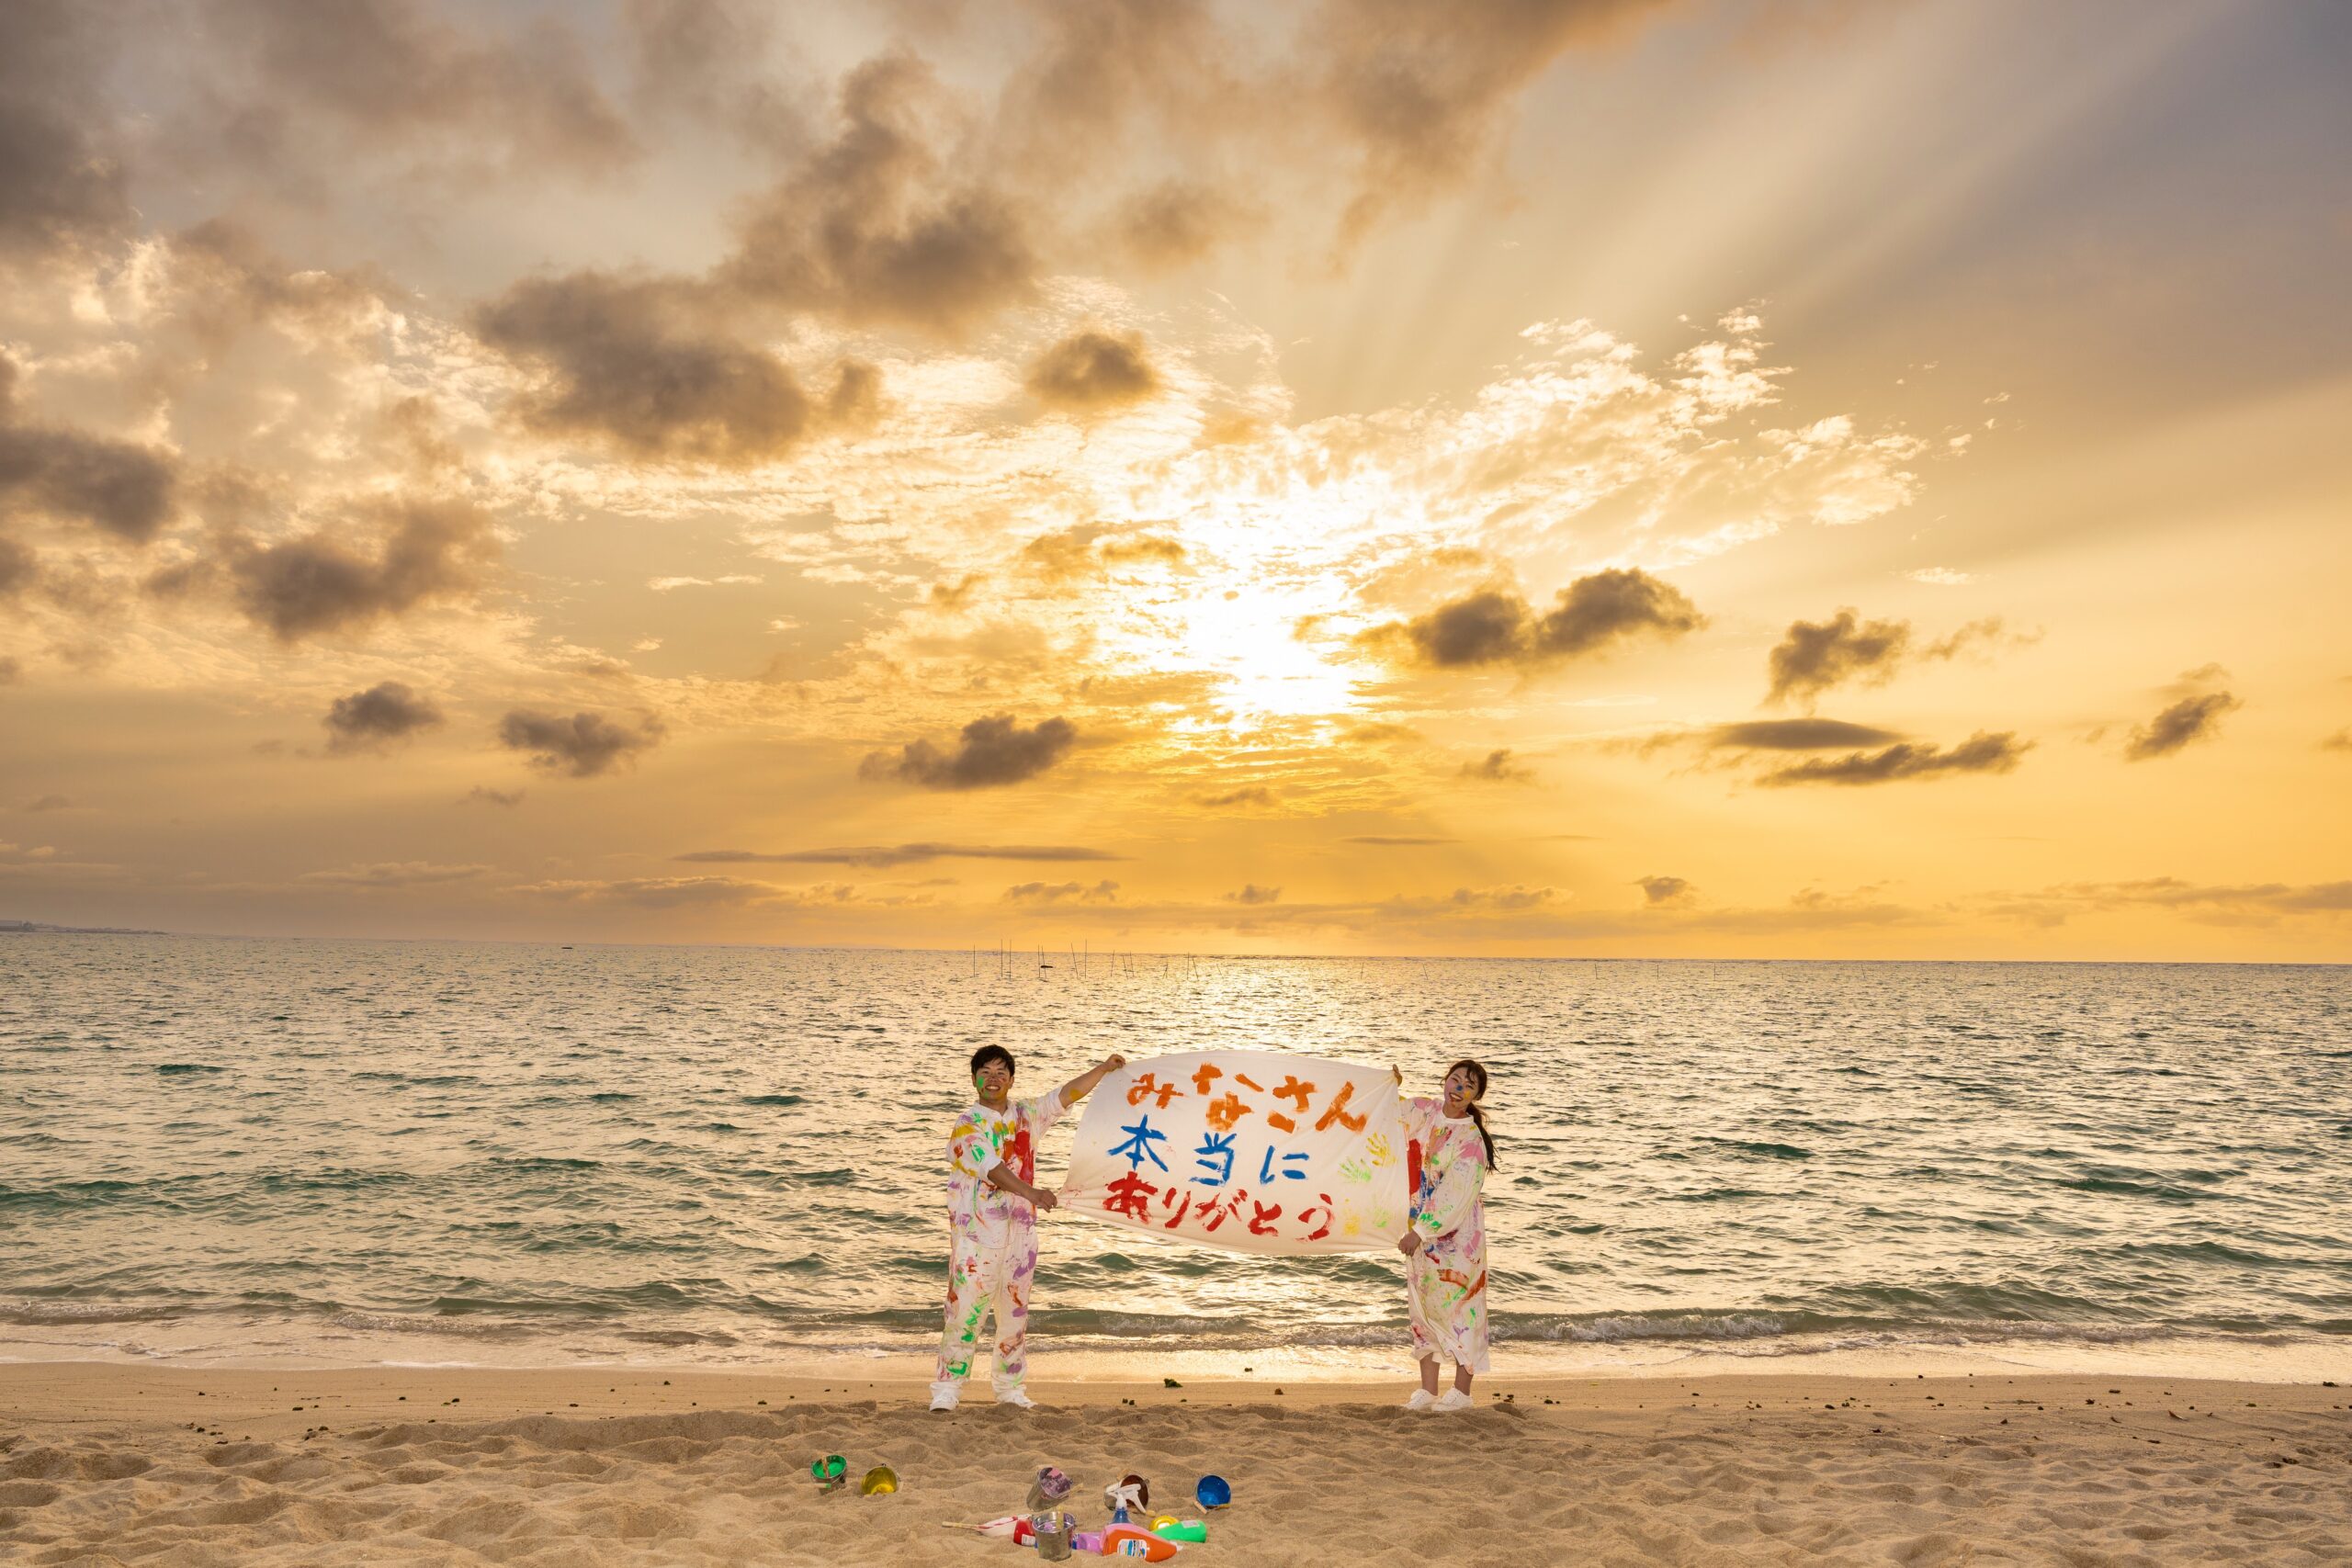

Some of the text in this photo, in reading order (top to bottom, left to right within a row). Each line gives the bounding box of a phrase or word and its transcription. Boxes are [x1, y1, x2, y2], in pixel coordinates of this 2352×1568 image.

[1127, 1062, 1368, 1134] みなさん
[1107, 1113, 1309, 1187] 本当に
[1102, 1170, 1335, 1242] ありがとう
